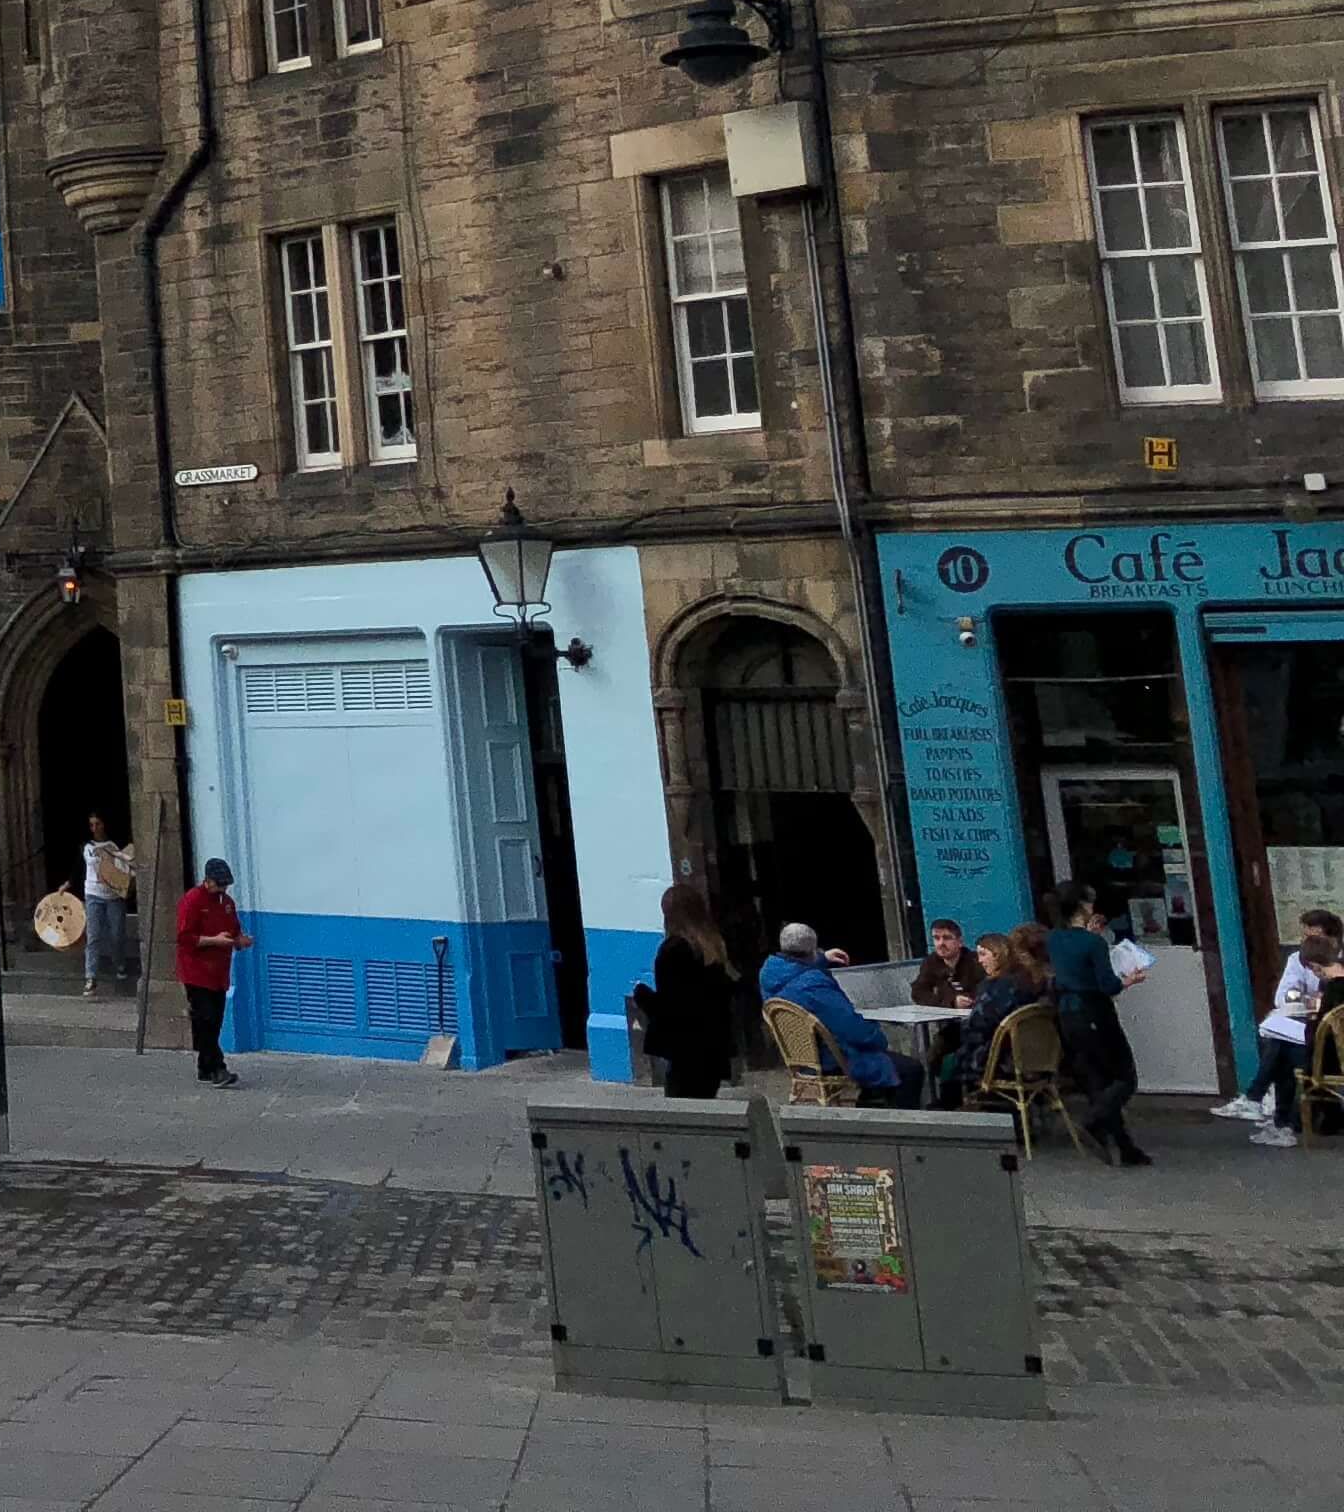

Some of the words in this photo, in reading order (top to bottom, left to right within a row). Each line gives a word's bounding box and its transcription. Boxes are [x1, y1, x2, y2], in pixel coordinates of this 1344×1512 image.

[179, 467, 253, 483] GRASSMARKET
[1064, 533, 1205, 584] Café
[947, 554, 981, 585] 10
[1089, 583, 1209, 598] BREAKFASTS
[932, 691, 988, 718] Jacques
[933, 807, 985, 822] SALADS
